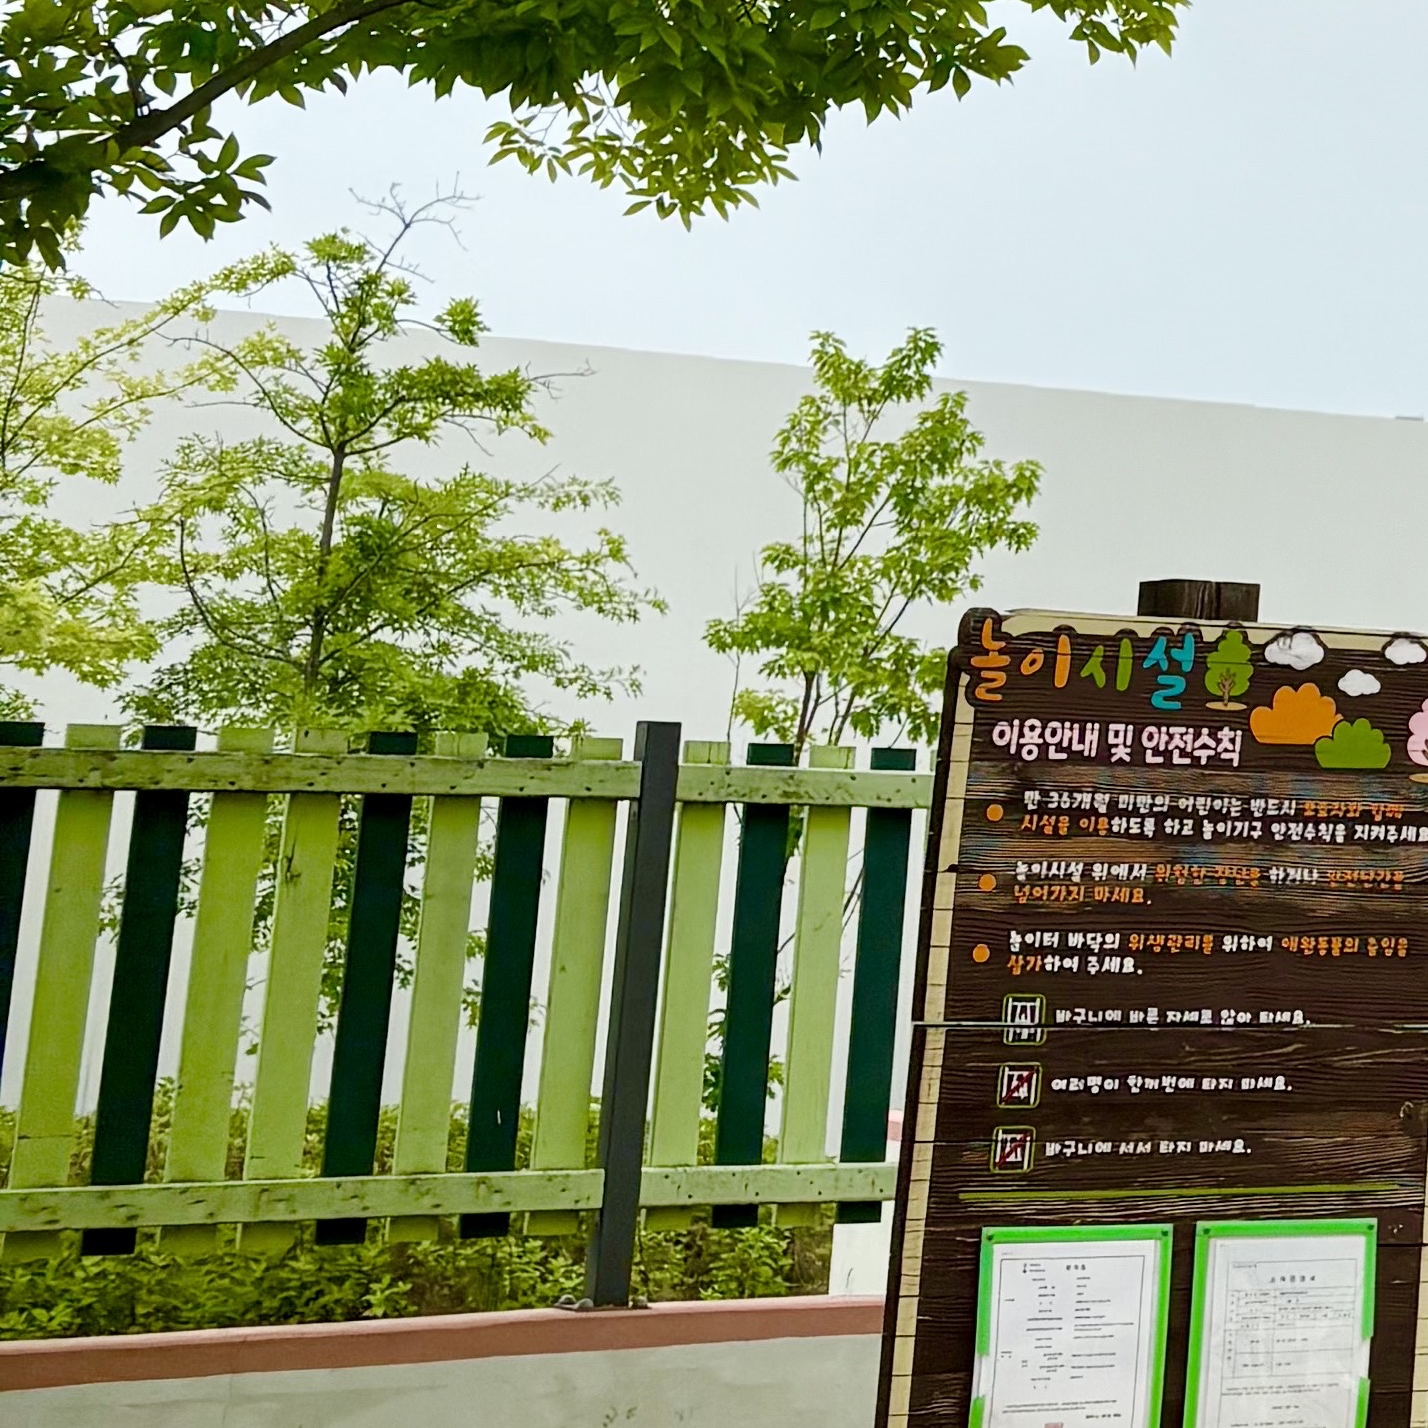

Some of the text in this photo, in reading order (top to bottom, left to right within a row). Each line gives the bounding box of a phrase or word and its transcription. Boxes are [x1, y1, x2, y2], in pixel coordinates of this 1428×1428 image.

[970, 617, 1195, 711] 놀이시설
[992, 718, 1242, 767] 이용안내 및 안전수칙
[1024, 790, 1040, 811] 만
[1047, 791, 1111, 814] 36개월
[1118, 793, 1170, 814] 미만의
[1250, 798, 1296, 818] 반드시
[1021, 814, 1070, 836] 시설을
[1079, 815, 1156, 839] 이용하도록
[1164, 817, 1194, 836] 하고
[1202, 819, 1262, 841] 놀이기구
[1271, 822, 1346, 844] 안전수칙을
[1014, 860, 1084, 882] 놀이시설
[1092, 862, 1147, 882] 위에서
[1014, 885, 1151, 905] 넘어가지 마세요.
[1009, 930, 1059, 953] 놀이터
[1067, 931, 1120, 953] 바닥의
[1128, 933, 1214, 954] 위생관리를
[1222, 935, 1273, 953] 위하여
[1281, 936, 1359, 957] 애완동물의
[1007, 954, 1143, 975] 삼가하여 주세요.
[1055, 1008, 1122, 1024] 바구니에
[1129, 1007, 1159, 1025] 바른
[1166, 1009, 1213, 1025] 자세로
[1051, 1075, 1119, 1094] 여러명이
[1201, 1077, 1233, 1091] 타지
[1241, 1075, 1293, 1091] 마세요.
[1045, 1138, 1252, 1157] 바구니에 서서 타지 마세요.
